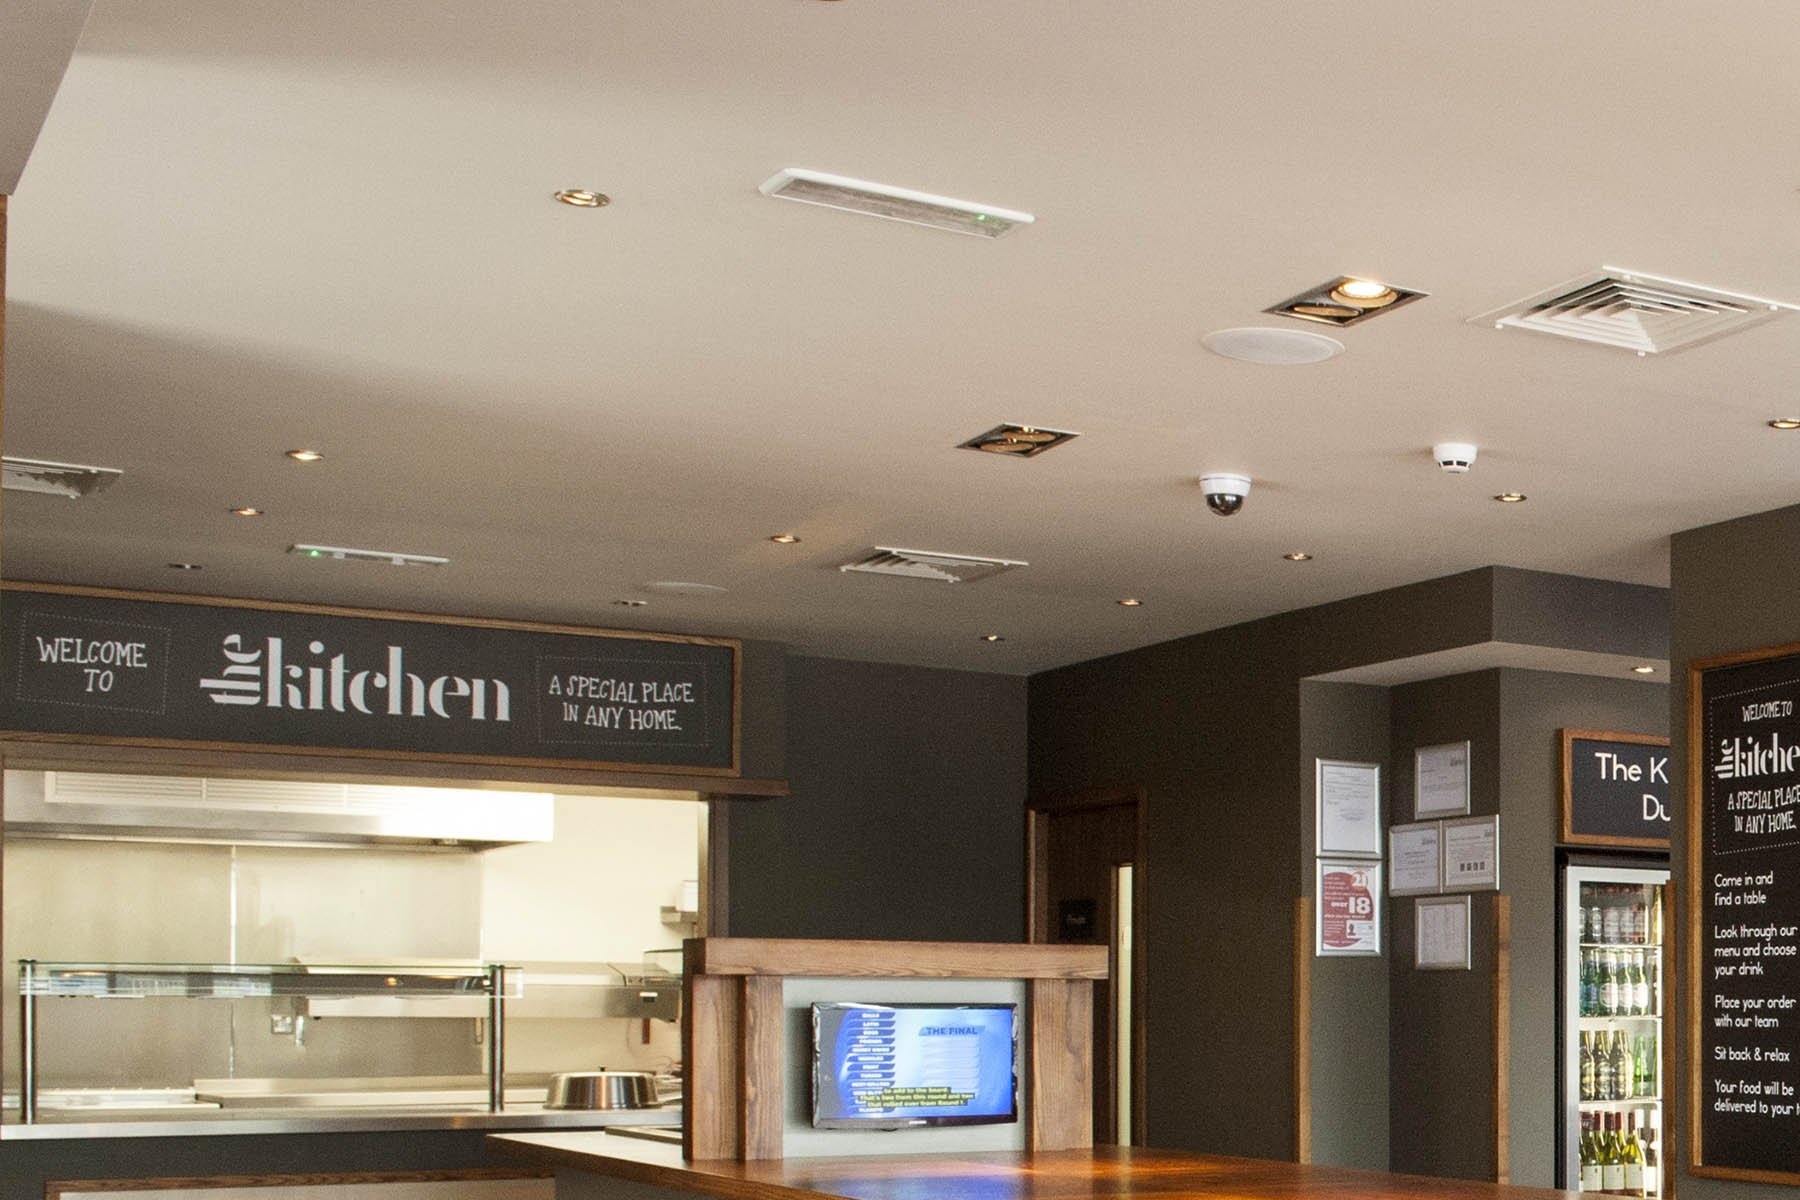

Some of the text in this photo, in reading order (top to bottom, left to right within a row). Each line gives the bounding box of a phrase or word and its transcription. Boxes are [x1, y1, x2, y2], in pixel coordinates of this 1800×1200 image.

[36, 636, 148, 669] WELCOME
[83, 668, 114, 692] TO
[199, 633, 511, 721] the kitchen
[548, 676, 695, 702] A SPECIAL PLACE
[562, 704, 579, 724] IN
[584, 706, 622, 730] ANY
[1742, 701, 1792, 722] WELCOME TO
[1594, 752, 1642, 782] The
[1715, 739, 1734, 779] the
[1728, 795, 1735, 810] A
[1736, 791, 1773, 810] SPECIAL
[1735, 816, 1743, 832] IN
[1746, 815, 1764, 834] ANY
[1715, 872, 1773, 887] Come in and
[1349, 897, 1370, 914] 18
[1715, 892, 1766, 906] find a table
[1715, 925, 1798, 941] Look through our
[1714, 943, 1797, 957] menu and choose
[1715, 962, 1764, 979] your drink
[1715, 995, 1796, 1012] Place your order
[1715, 1014, 1779, 1028] with our team
[927, 1027, 977, 1035] THE FINAL
[1715, 1047, 1790, 1062] Sit back & relax
[1715, 1080, 1794, 1096] Your food will be
[1714, 1100, 1756, 1114] delivered
[1759, 1101, 1768, 1114] to
[1771, 1102, 1794, 1118] your
